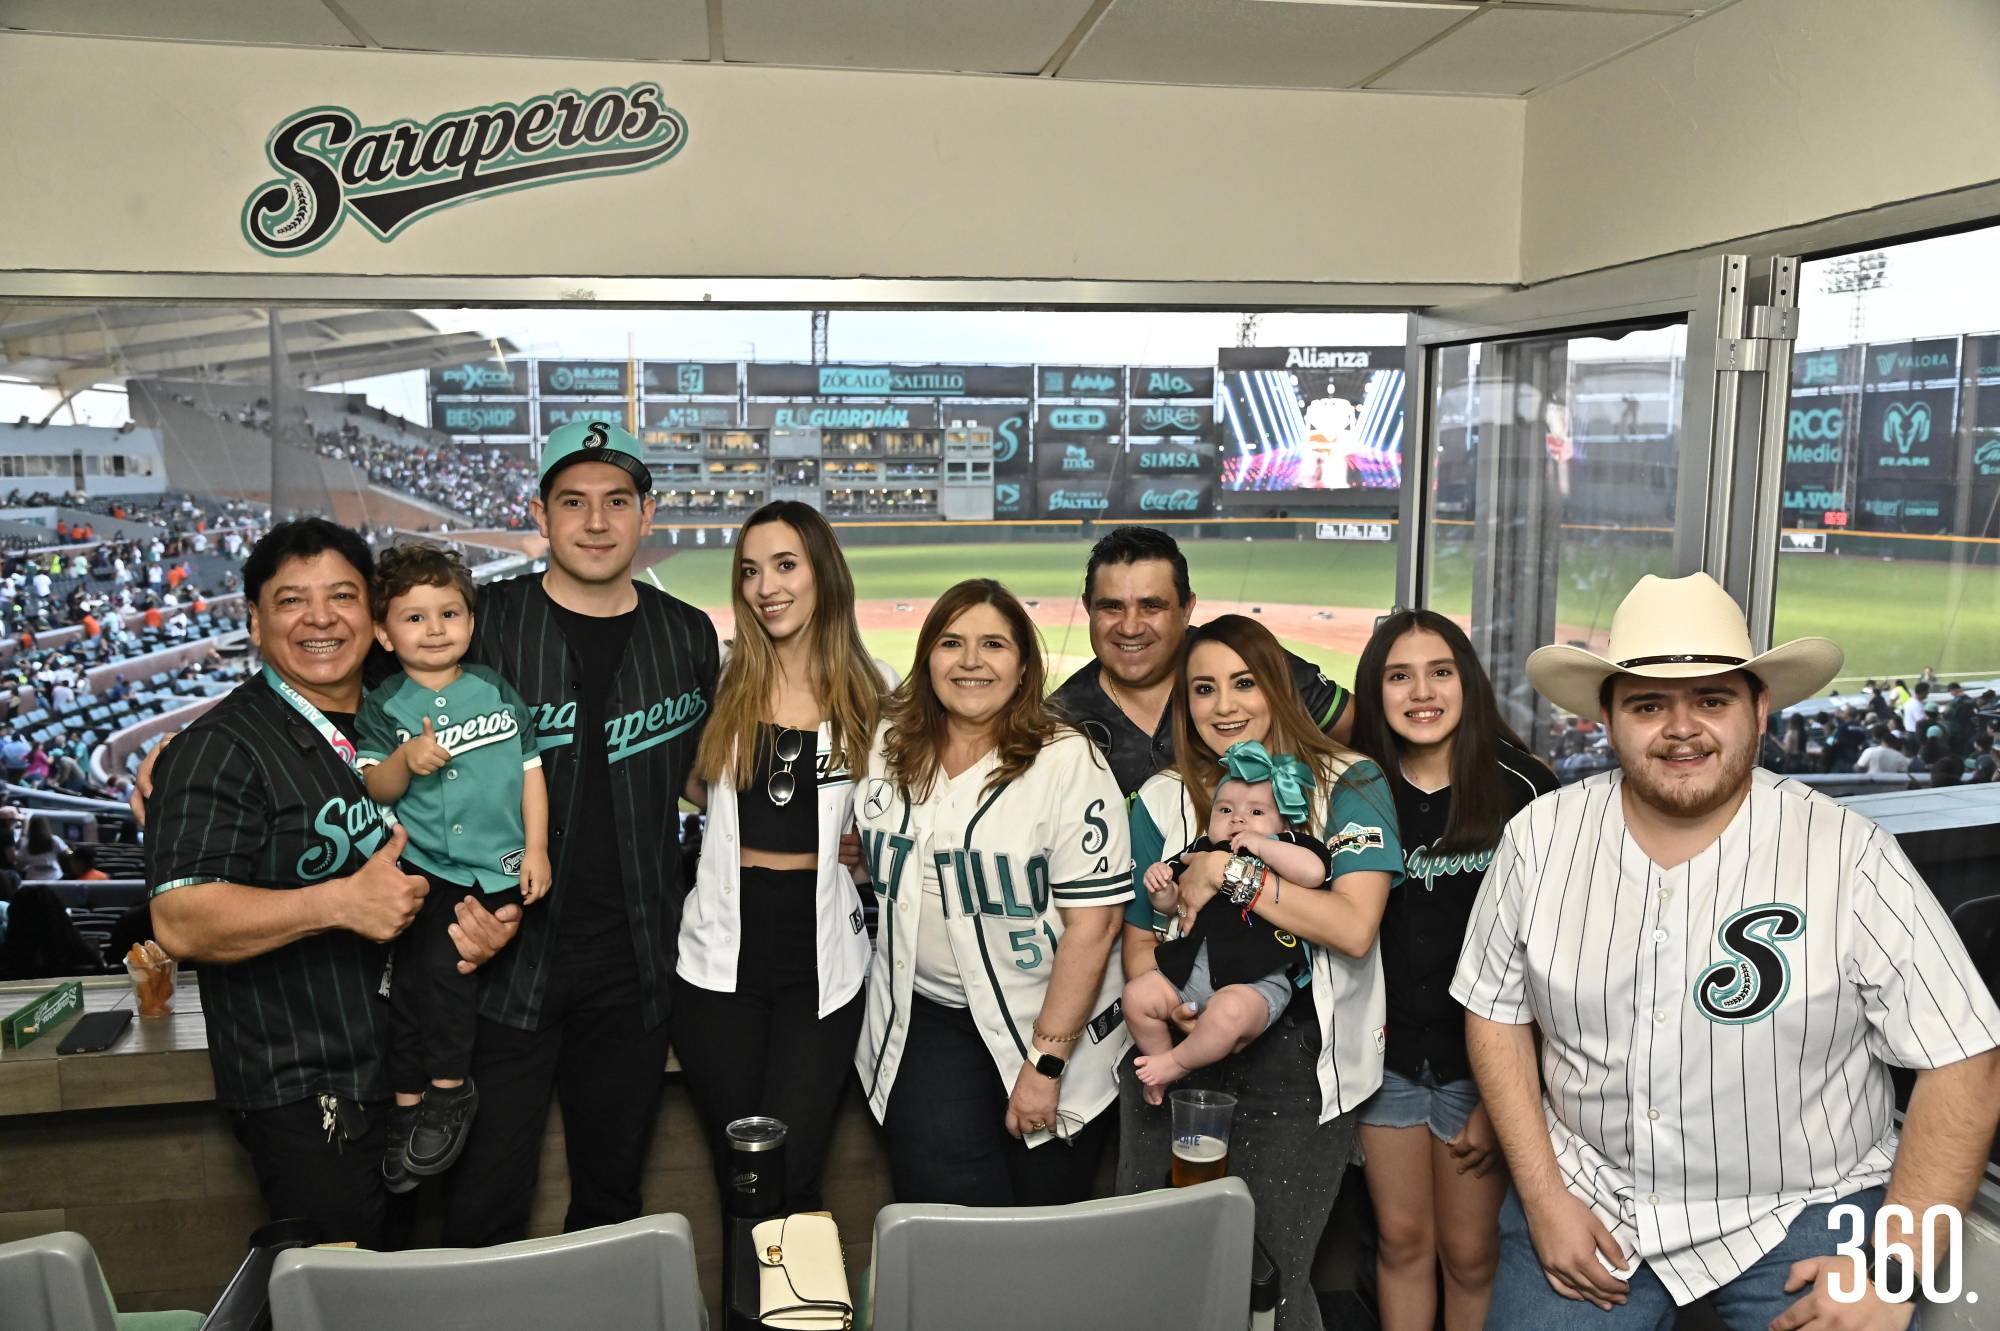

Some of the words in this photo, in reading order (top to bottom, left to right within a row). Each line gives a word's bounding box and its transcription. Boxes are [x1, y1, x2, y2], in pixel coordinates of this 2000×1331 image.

[246, 85, 684, 252] Saraperos
[1285, 347, 1369, 368] Alianza
[1898, 353, 1949, 368] VALORA
[822, 371, 885, 388] ZÓCALO
[893, 374, 963, 389] SALTILLO
[1788, 408, 1842, 439] RCG
[1140, 452, 1200, 468] SIMSA
[1787, 444, 1842, 463] Media
[1693, 902, 1807, 1025] S
